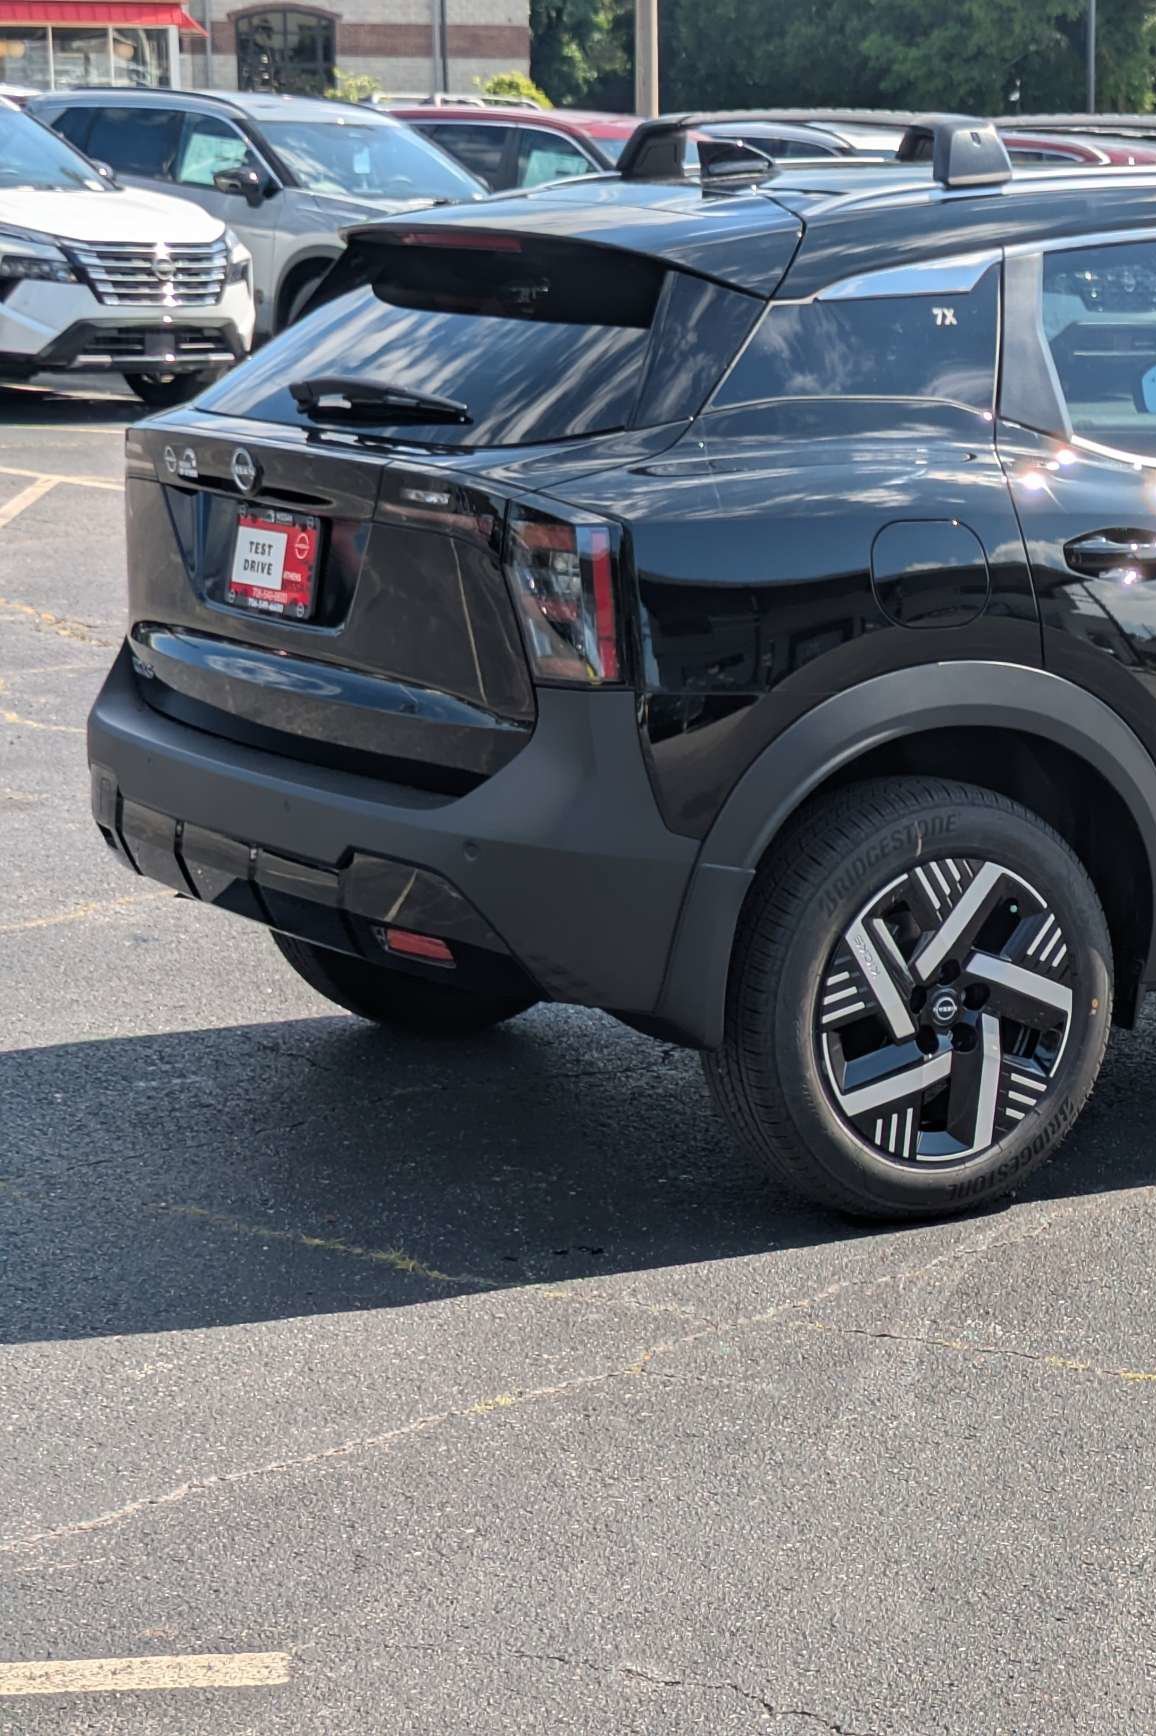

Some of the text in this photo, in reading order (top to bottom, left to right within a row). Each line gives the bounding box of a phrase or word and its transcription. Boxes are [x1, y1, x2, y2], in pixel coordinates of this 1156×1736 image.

[243, 558, 273, 576] DRIVE
[249, 541, 274, 557] TEST
[818, 813, 957, 919] BRIDGESTONE
[948, 1095, 1078, 1201] BRIDGESTONE
